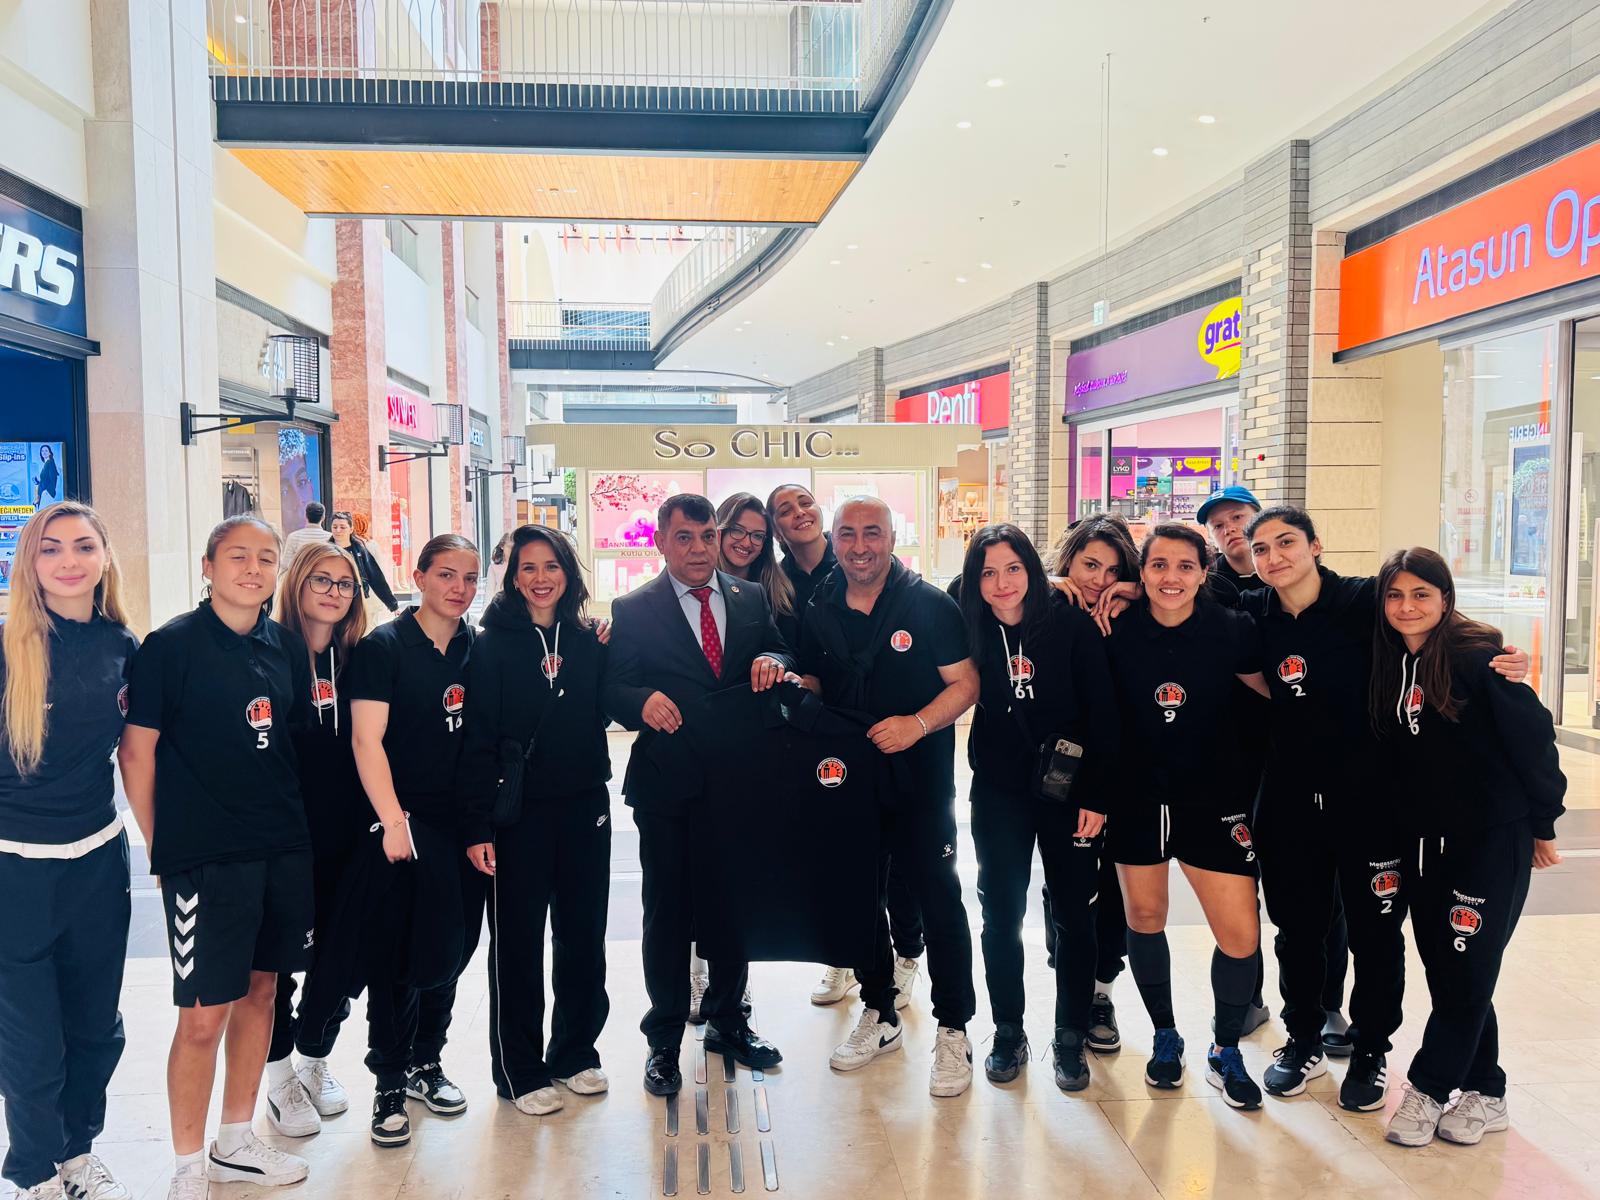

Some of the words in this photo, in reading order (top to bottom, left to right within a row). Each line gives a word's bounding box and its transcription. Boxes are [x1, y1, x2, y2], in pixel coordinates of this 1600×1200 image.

[1413, 222, 1531, 304] Atasun
[928, 380, 976, 424] Penti
[655, 430, 716, 459] So
[1015, 684, 1035, 699] 61
[1291, 684, 1307, 697] 2
[1163, 709, 1176, 723] 9
[1409, 717, 1420, 735] 6
[256, 732, 269, 750] 5
[1453, 889, 1486, 904] Megasaray
[1380, 899, 1393, 914] 2
[1453, 936, 1467, 952] 6
